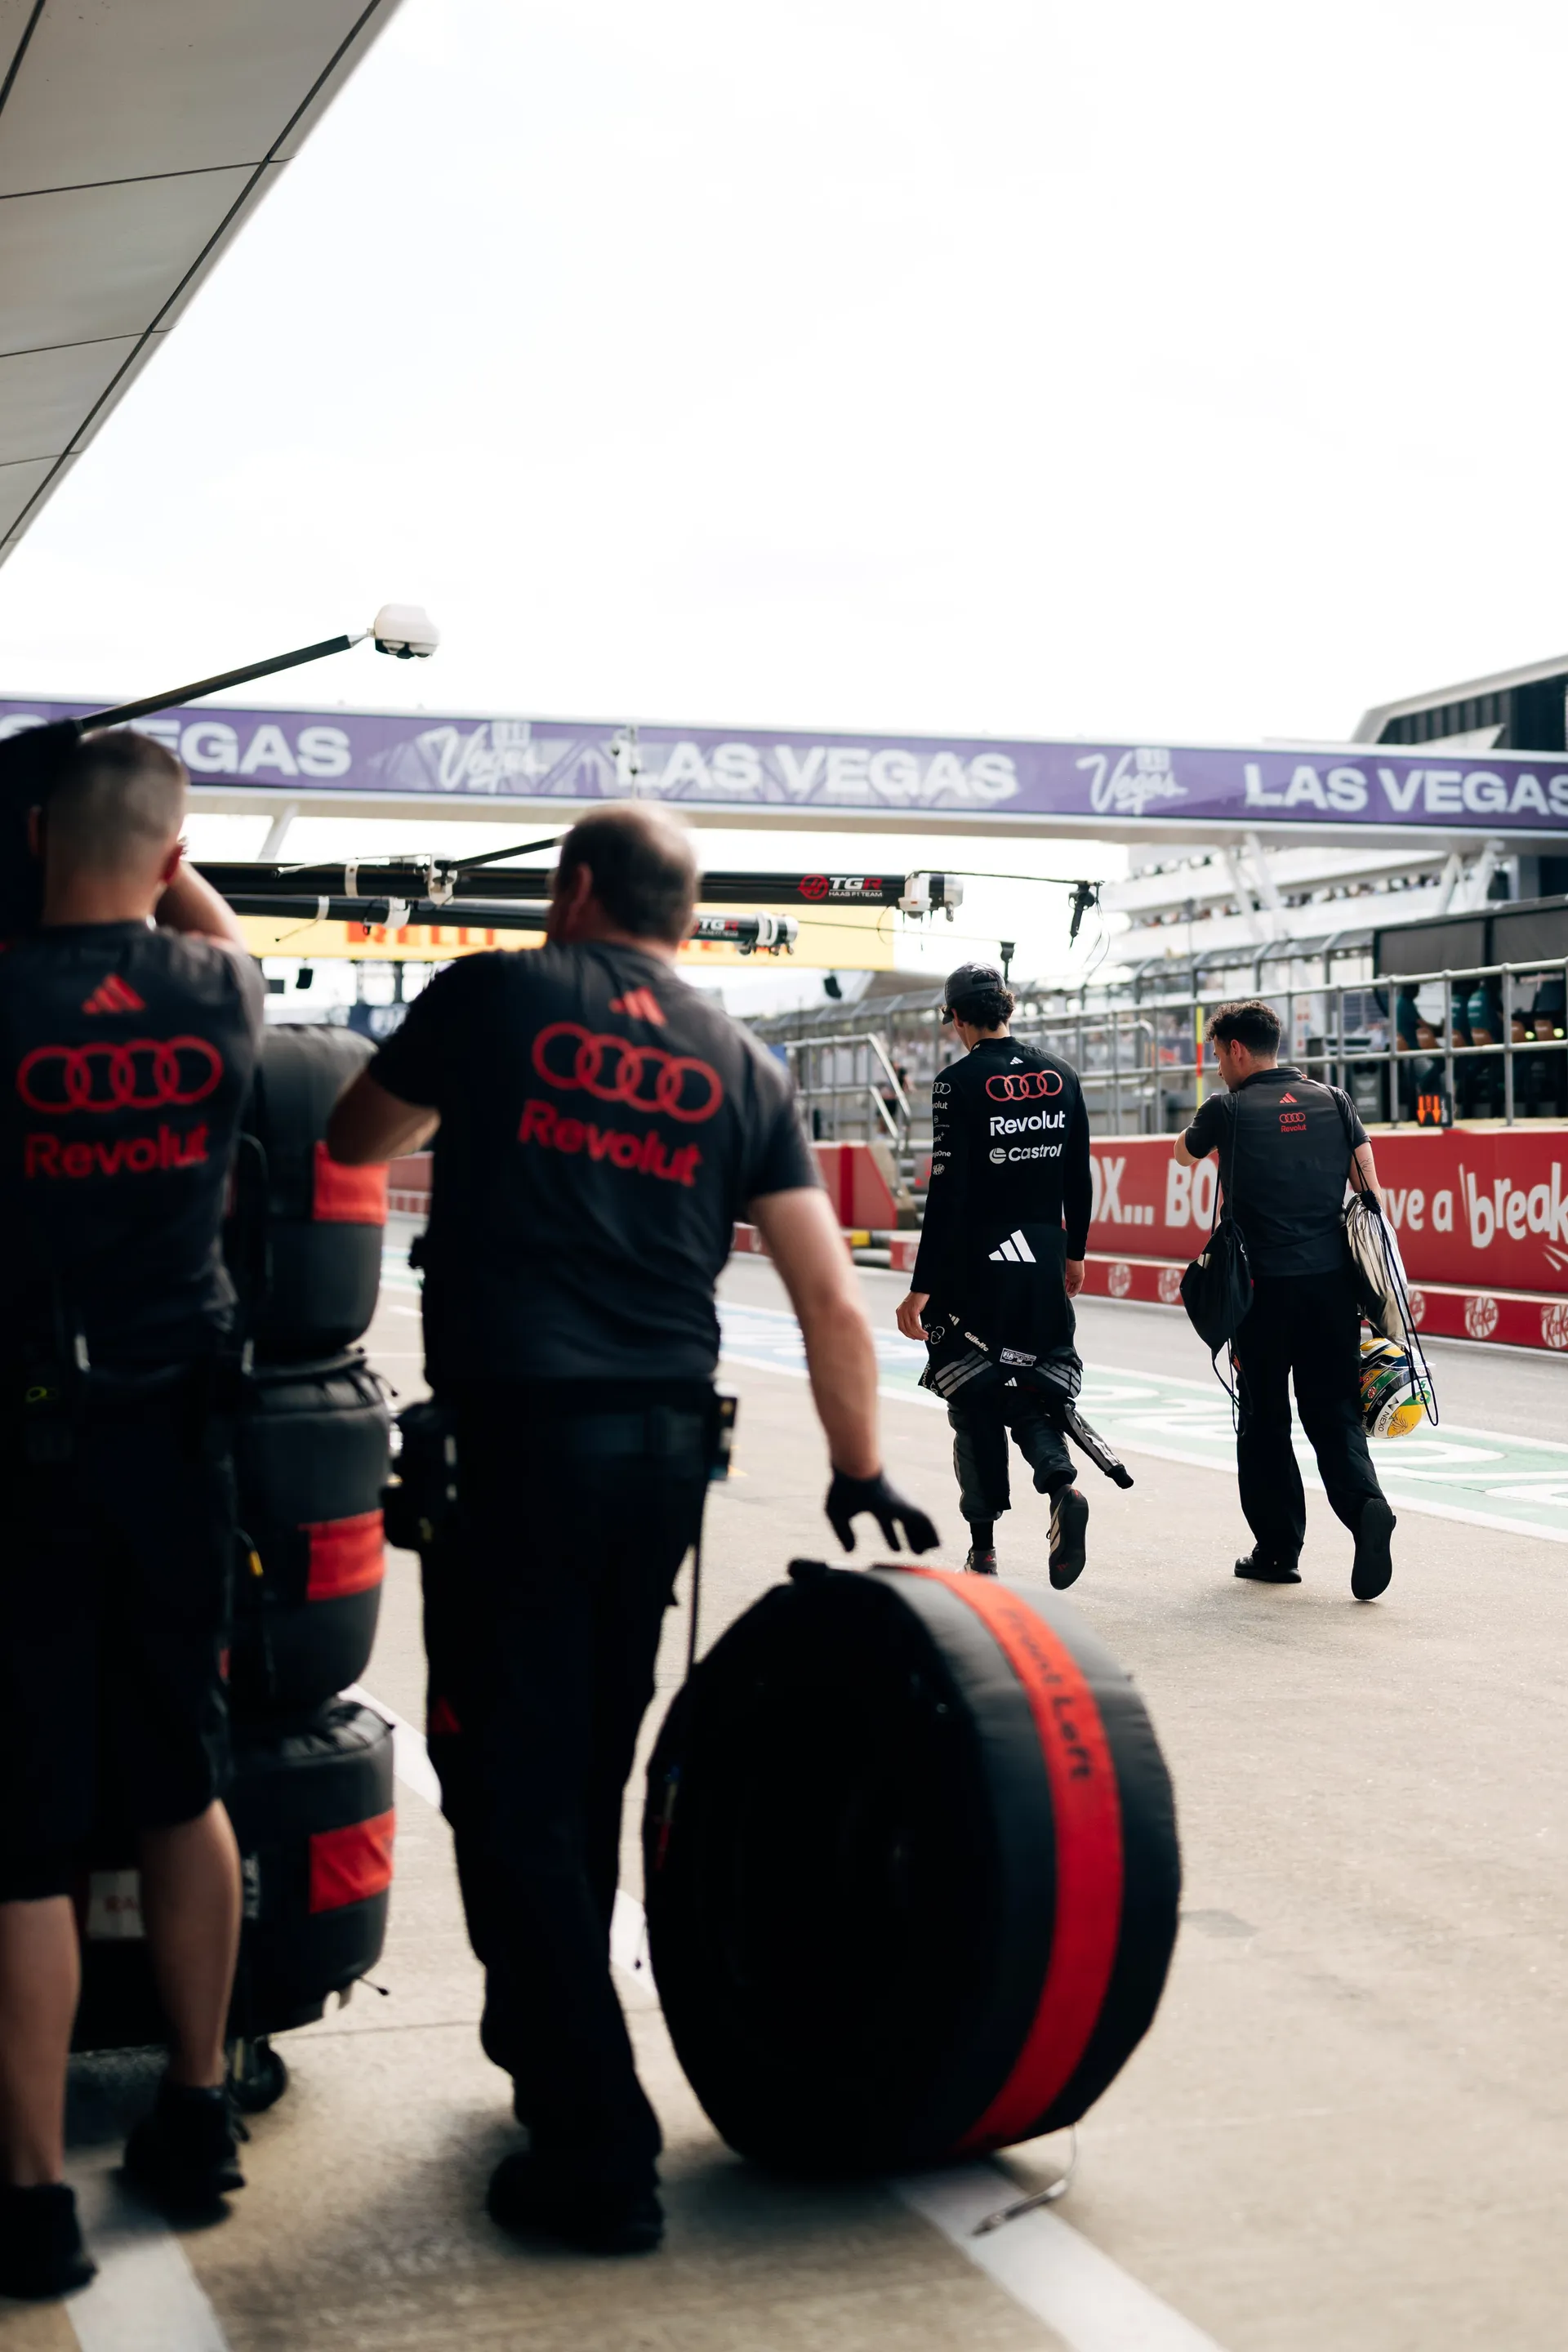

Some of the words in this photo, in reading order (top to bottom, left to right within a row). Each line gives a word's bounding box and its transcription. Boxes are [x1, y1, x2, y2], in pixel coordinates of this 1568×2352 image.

[614, 737, 762, 792] LAS
[774, 744, 1019, 800] VEGAS
[1244, 764, 1369, 811] LAS
[829, 876, 882, 890] TGR
[700, 918, 739, 931] TGR
[990, 1110, 1066, 1137] Revolut
[1281, 1124, 1307, 1134] Revolut
[24, 1121, 209, 1179] Revolut
[517, 1098, 704, 1187] Revolut
[1008, 1143, 1063, 1162] Castrol
[1432, 1189, 1454, 1232] a
[964, 1331, 989, 1352] Gillette
[1378, 1410, 1390, 1432] NEXO
[1052, 1696, 1093, 1782] Left
